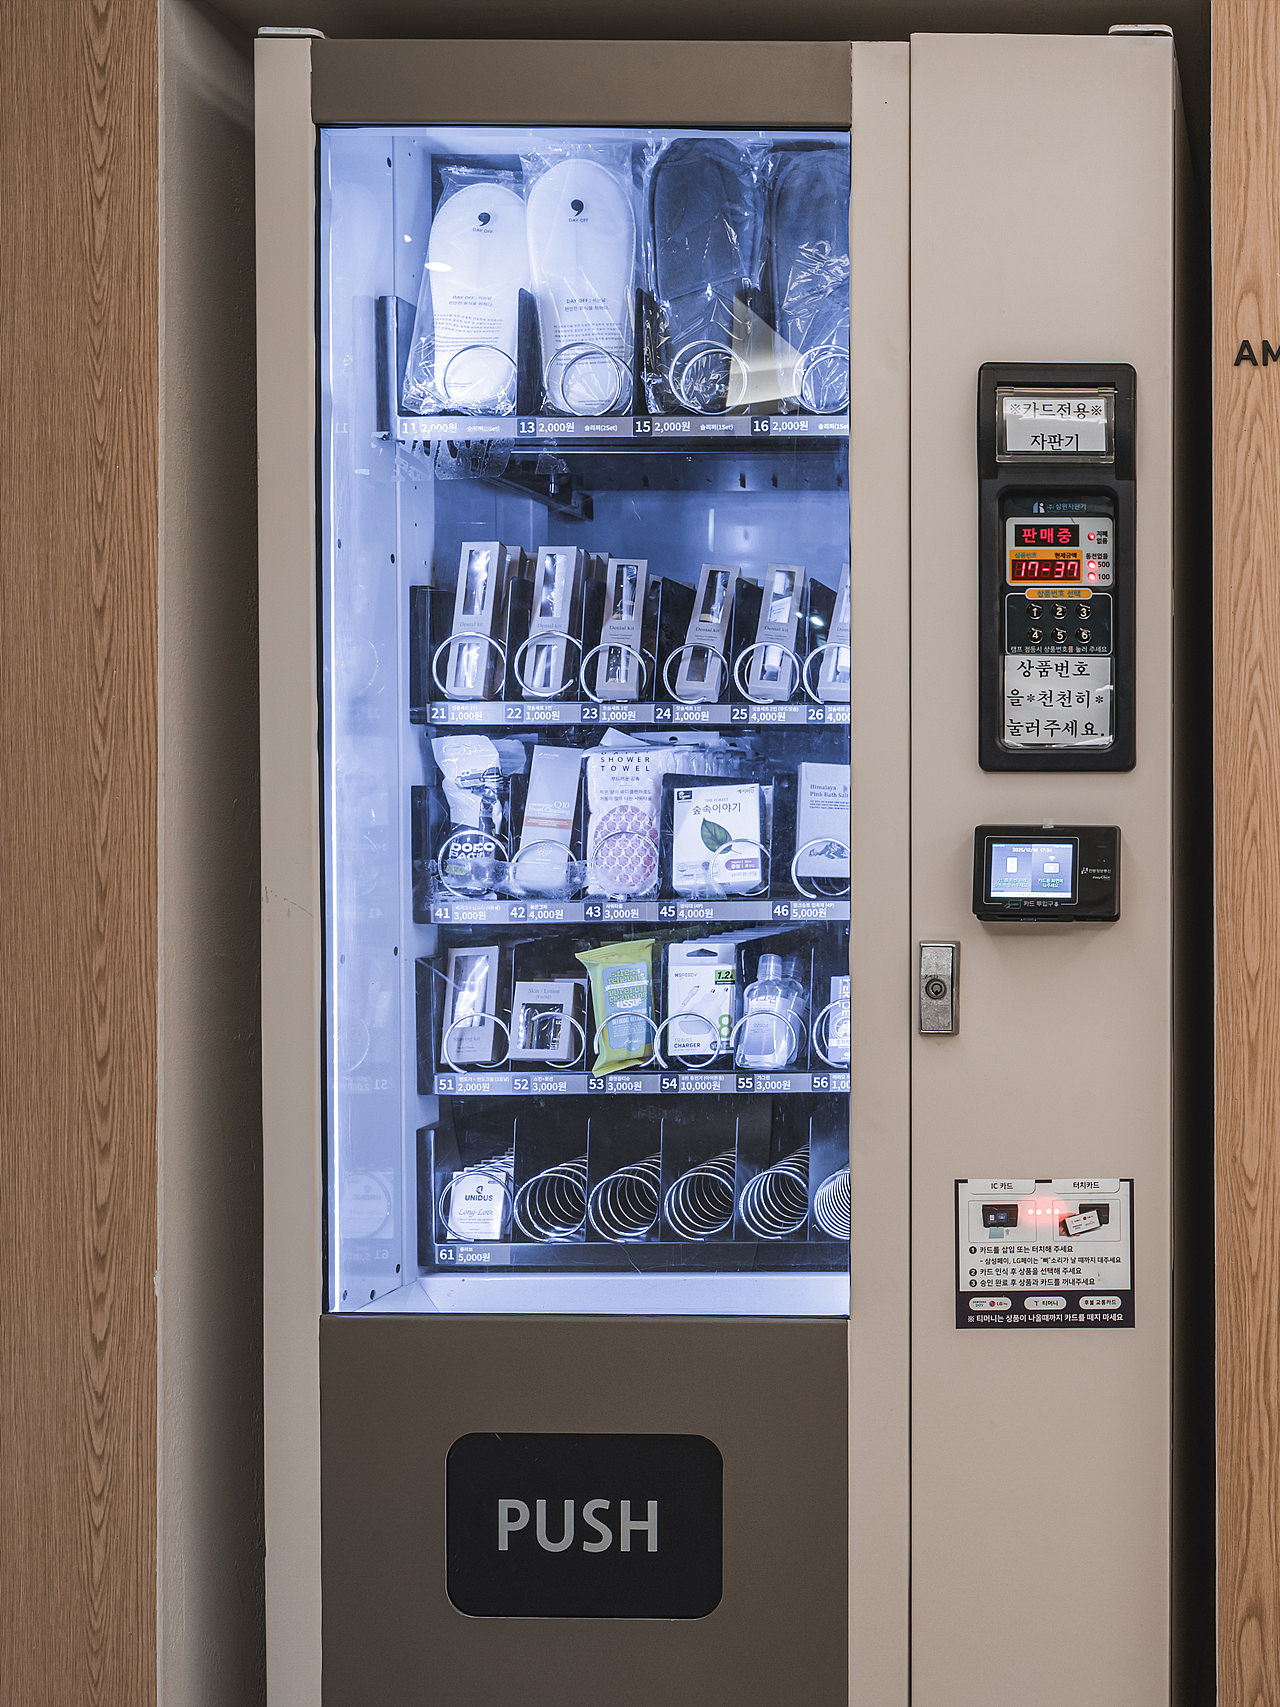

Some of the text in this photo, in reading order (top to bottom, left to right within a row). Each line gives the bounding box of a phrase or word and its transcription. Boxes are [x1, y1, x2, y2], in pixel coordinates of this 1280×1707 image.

[520, 422, 535, 433] 13
[538, 422, 575, 433] 2,000원
[635, 421, 650, 432] 15
[654, 421, 690, 432] 2,000원
[753, 420, 808, 432] 16 2,000원
[1030, 433, 1079, 451] 자판기
[1021, 528, 1072, 544] 판매중
[1037, 590, 1064, 598] 상품번호
[1017, 659, 1090, 678] 상품번호
[431, 708, 446, 719] 21
[450, 711, 482, 721] 1,000원
[507, 708, 522, 719] 22
[526, 711, 560, 721] 1,000원
[582, 708, 598, 719] 23
[602, 711, 636, 721] 1,000원
[656, 708, 671, 719] 24
[675, 711, 709, 721] 1,000원
[732, 709, 747, 719] 25
[751, 712, 785, 722] 4,000원
[808, 709, 823, 720] 26
[1007, 719, 1104, 737] 눌러주세요.
[554, 801, 569, 809] Q10
[693, 803, 741, 815] 숲속이야기
[435, 908, 450, 919] 41
[454, 910, 486, 921] 3,000원
[510, 907, 525, 918] 42
[529, 909, 563, 920] 4,000원
[586, 907, 601, 918] 43
[605, 908, 639, 919] 3,000원
[660, 906, 676, 917] 45
[679, 908, 713, 919] 4,000원
[773, 905, 789, 916] 46
[793, 908, 826, 918] 5,000원
[617, 998, 642, 1008] tissue
[439, 1079, 453, 1090] 51
[458, 1083, 490, 1092] 2,000원
[514, 1079, 529, 1090] 52
[532, 1082, 567, 1092] 3,000원
[589, 1079, 604, 1089] 53
[608, 1081, 642, 1091] 3,000원
[662, 1078, 677, 1089] 54
[681, 1080, 721, 1091] 10,000원
[737, 1078, 753, 1089] 55
[756, 1080, 791, 1091] 3,000원
[813, 1077, 828, 1088] 56
[439, 1250, 455, 1260] 61
[980, 1246, 1000, 1254] 카드를
[458, 1252, 490, 1263] 5,000원
[498, 1498, 658, 1553] PUSH
